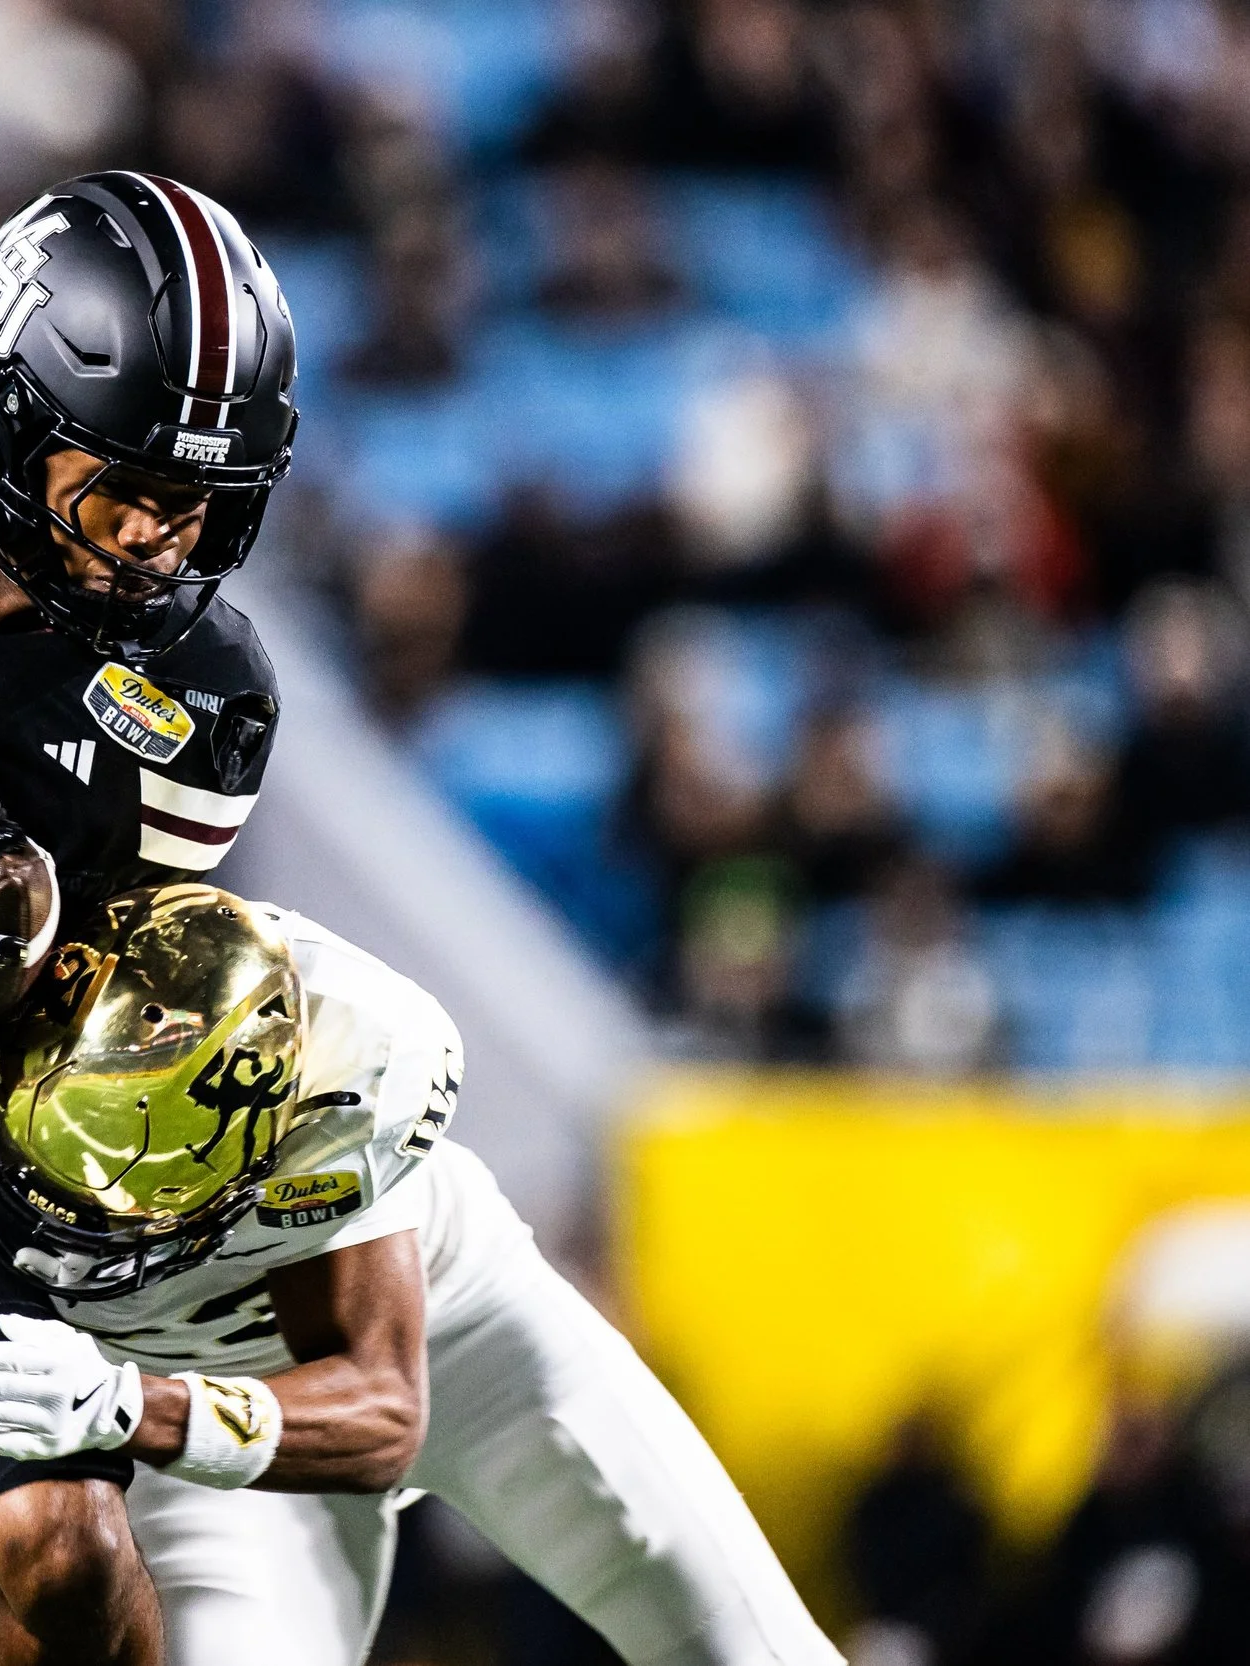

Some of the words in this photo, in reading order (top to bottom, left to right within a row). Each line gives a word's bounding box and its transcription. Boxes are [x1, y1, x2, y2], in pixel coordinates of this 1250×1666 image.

[172, 441, 229, 464] STATE
[176, 431, 231, 448] MISSISSIPPI
[120, 678, 177, 724] Duke's
[185, 689, 225, 715] RND
[100, 705, 152, 754] BOWL
[274, 1175, 339, 1202] Duke's
[27, 1188, 77, 1225] DEACS
[280, 1206, 344, 1230] BOWL
